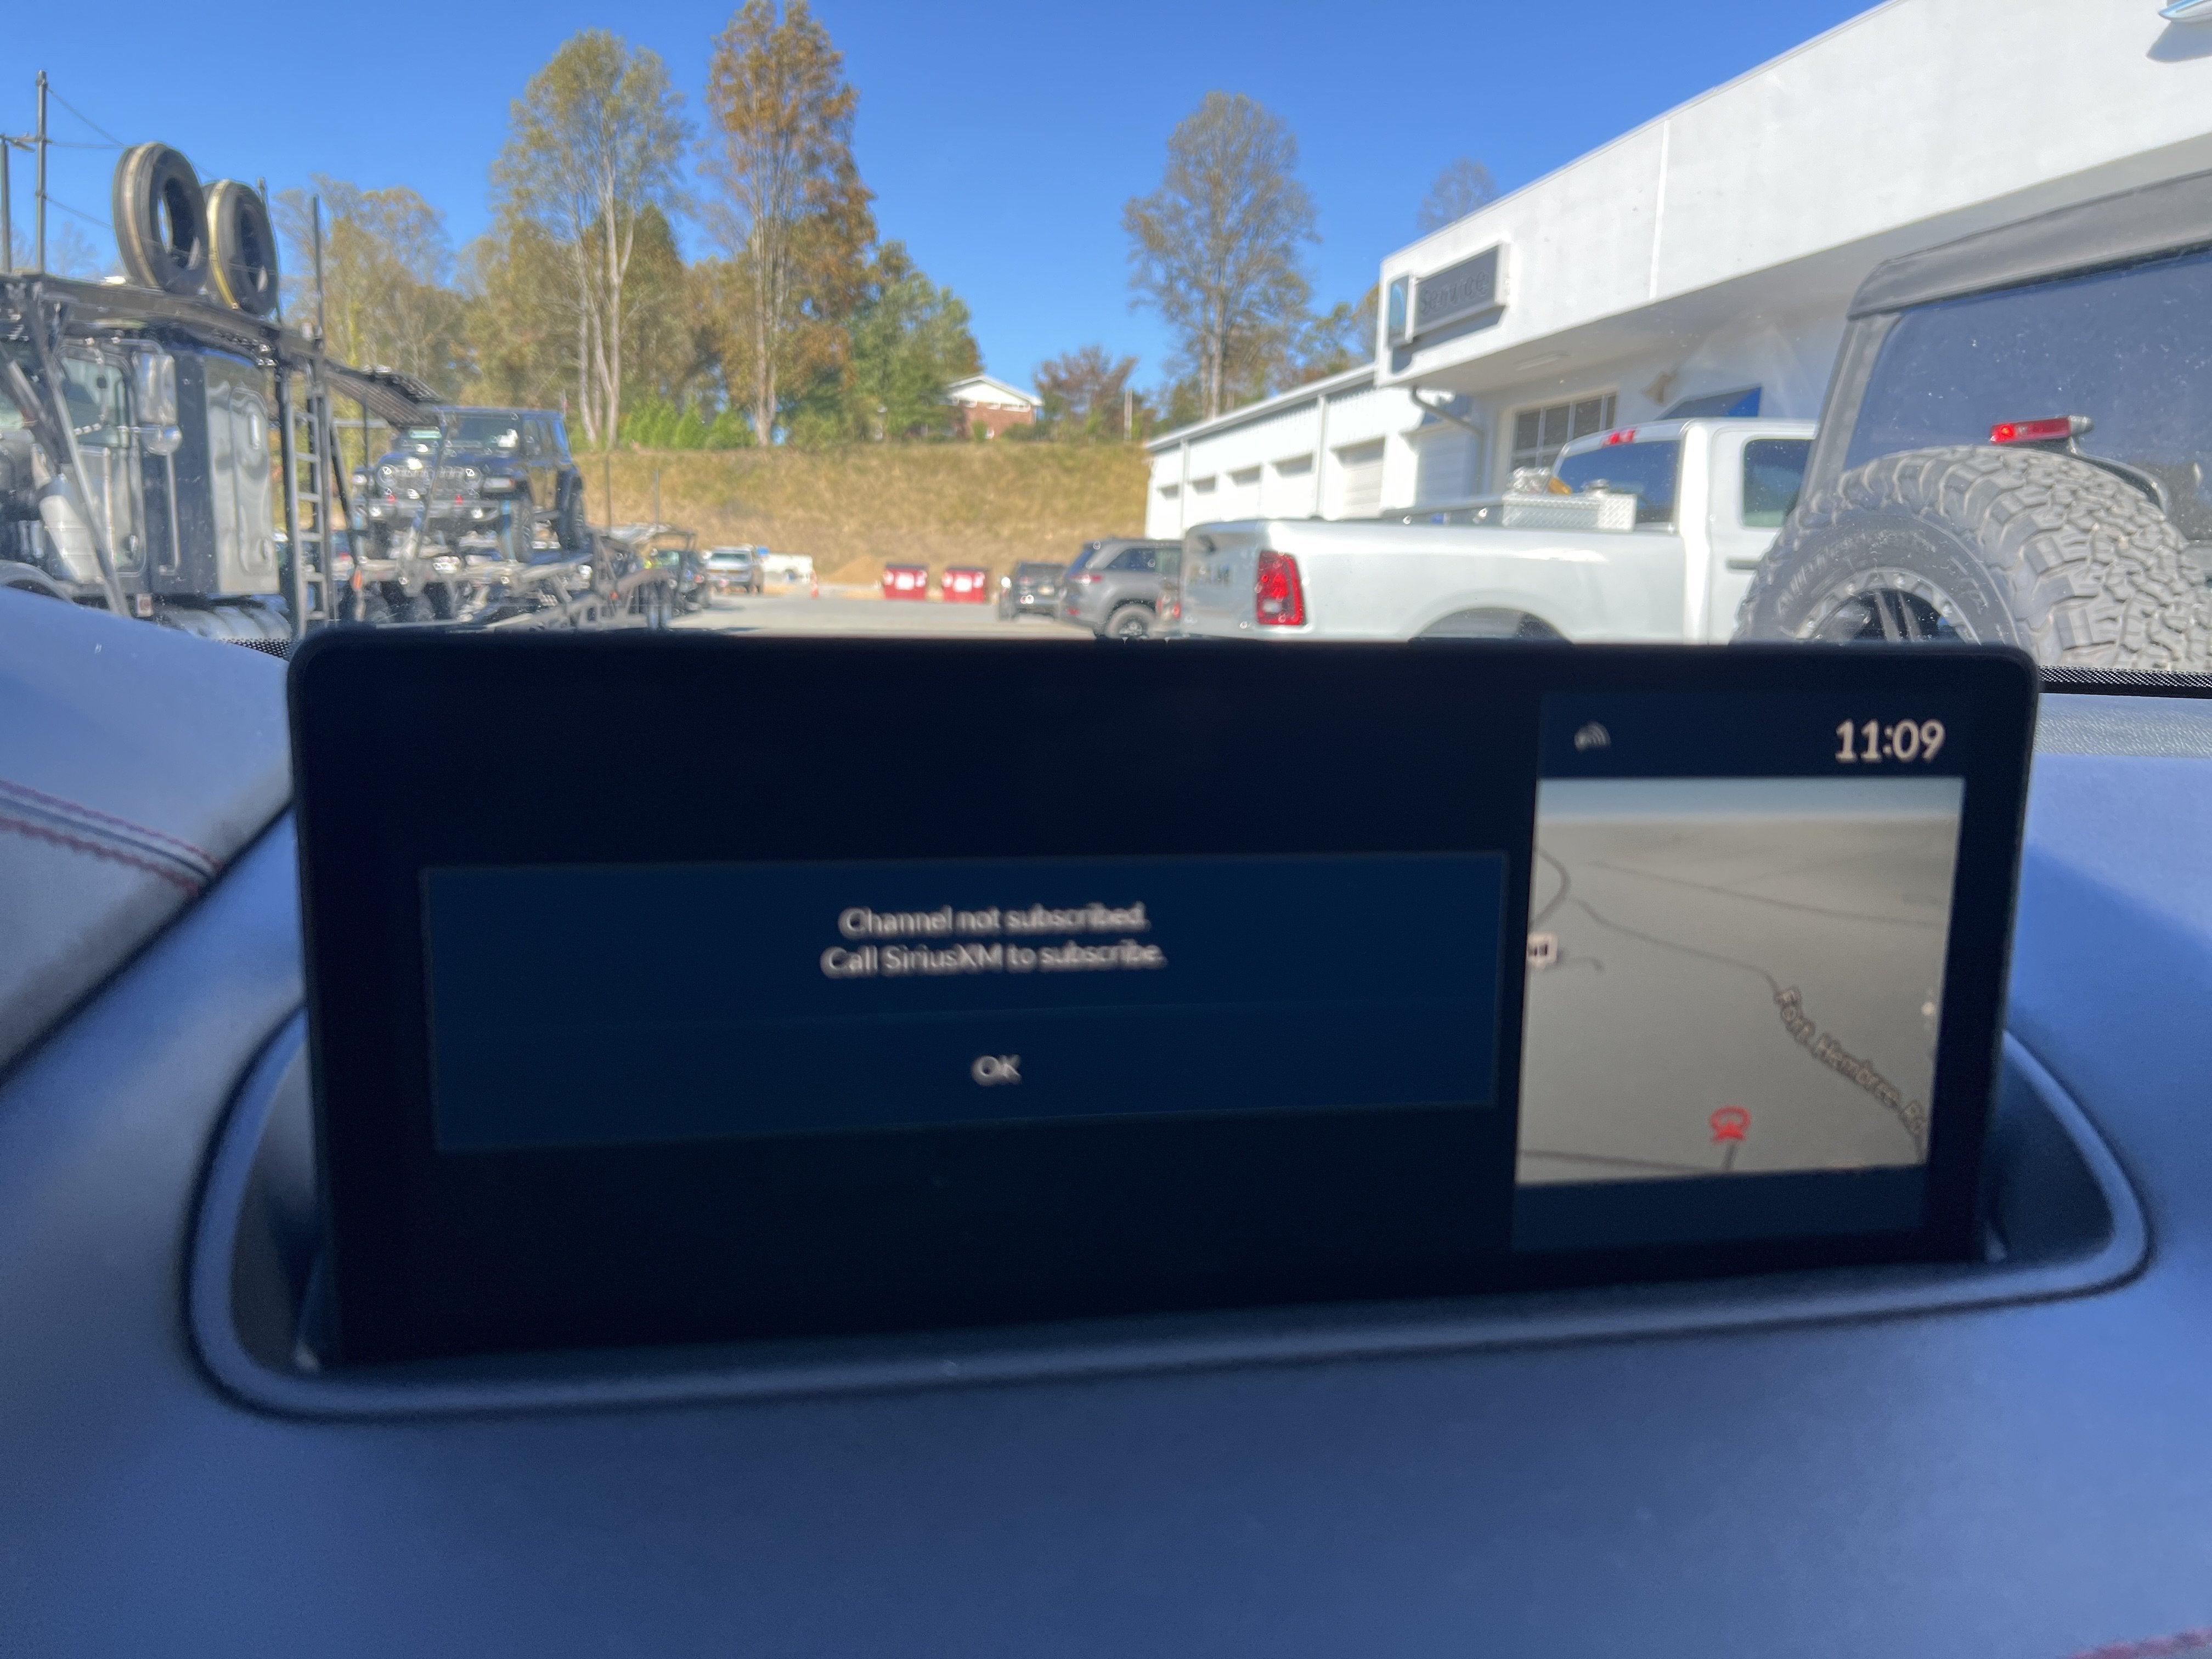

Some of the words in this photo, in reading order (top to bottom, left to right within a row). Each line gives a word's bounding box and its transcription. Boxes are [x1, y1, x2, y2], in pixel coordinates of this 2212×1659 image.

[1836, 719, 1945, 763] 11:09
[839, 905, 953, 938] Channel
[956, 907, 1001, 934] not
[821, 945, 878, 978] Call
[881, 944, 1003, 975] SiriusXM
[1006, 944, 1037, 973] to
[972, 1054, 1022, 1086] OK
